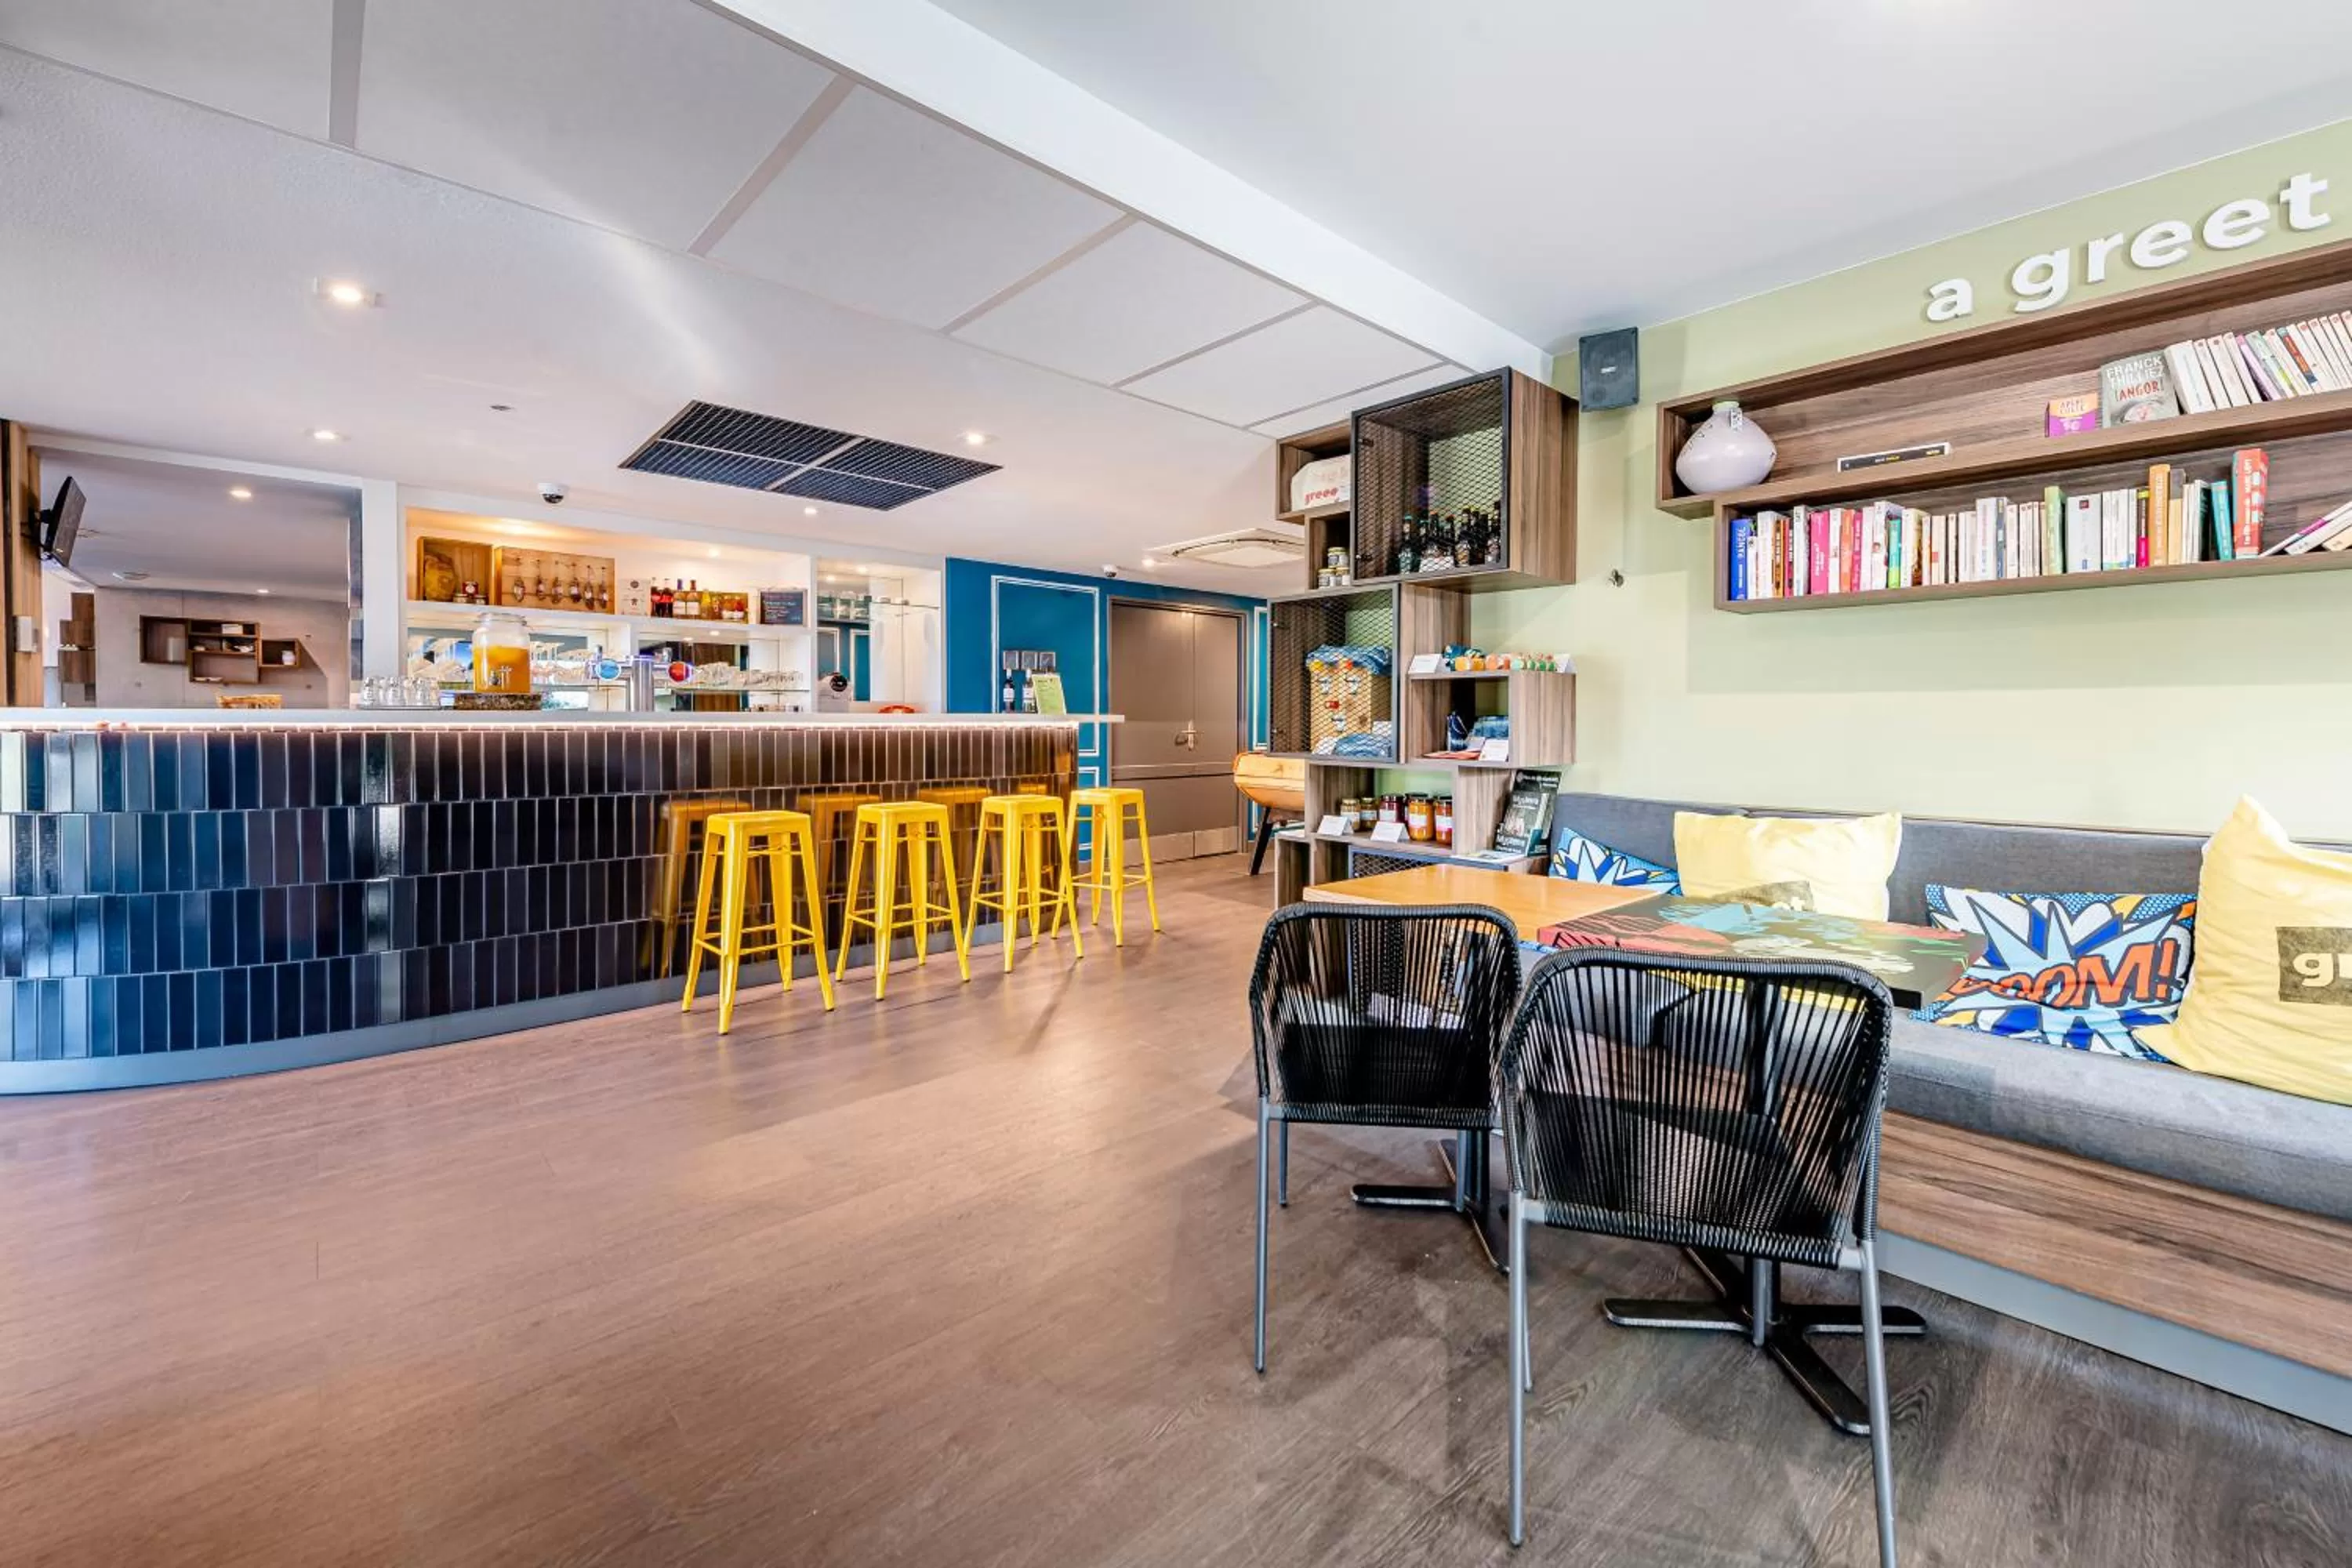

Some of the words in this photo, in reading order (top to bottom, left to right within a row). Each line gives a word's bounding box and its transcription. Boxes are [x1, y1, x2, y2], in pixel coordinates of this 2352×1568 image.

[1926, 277, 1974, 322] a
[2010, 172, 2332, 314] greet
[2106, 355, 2163, 380] FRANCK
